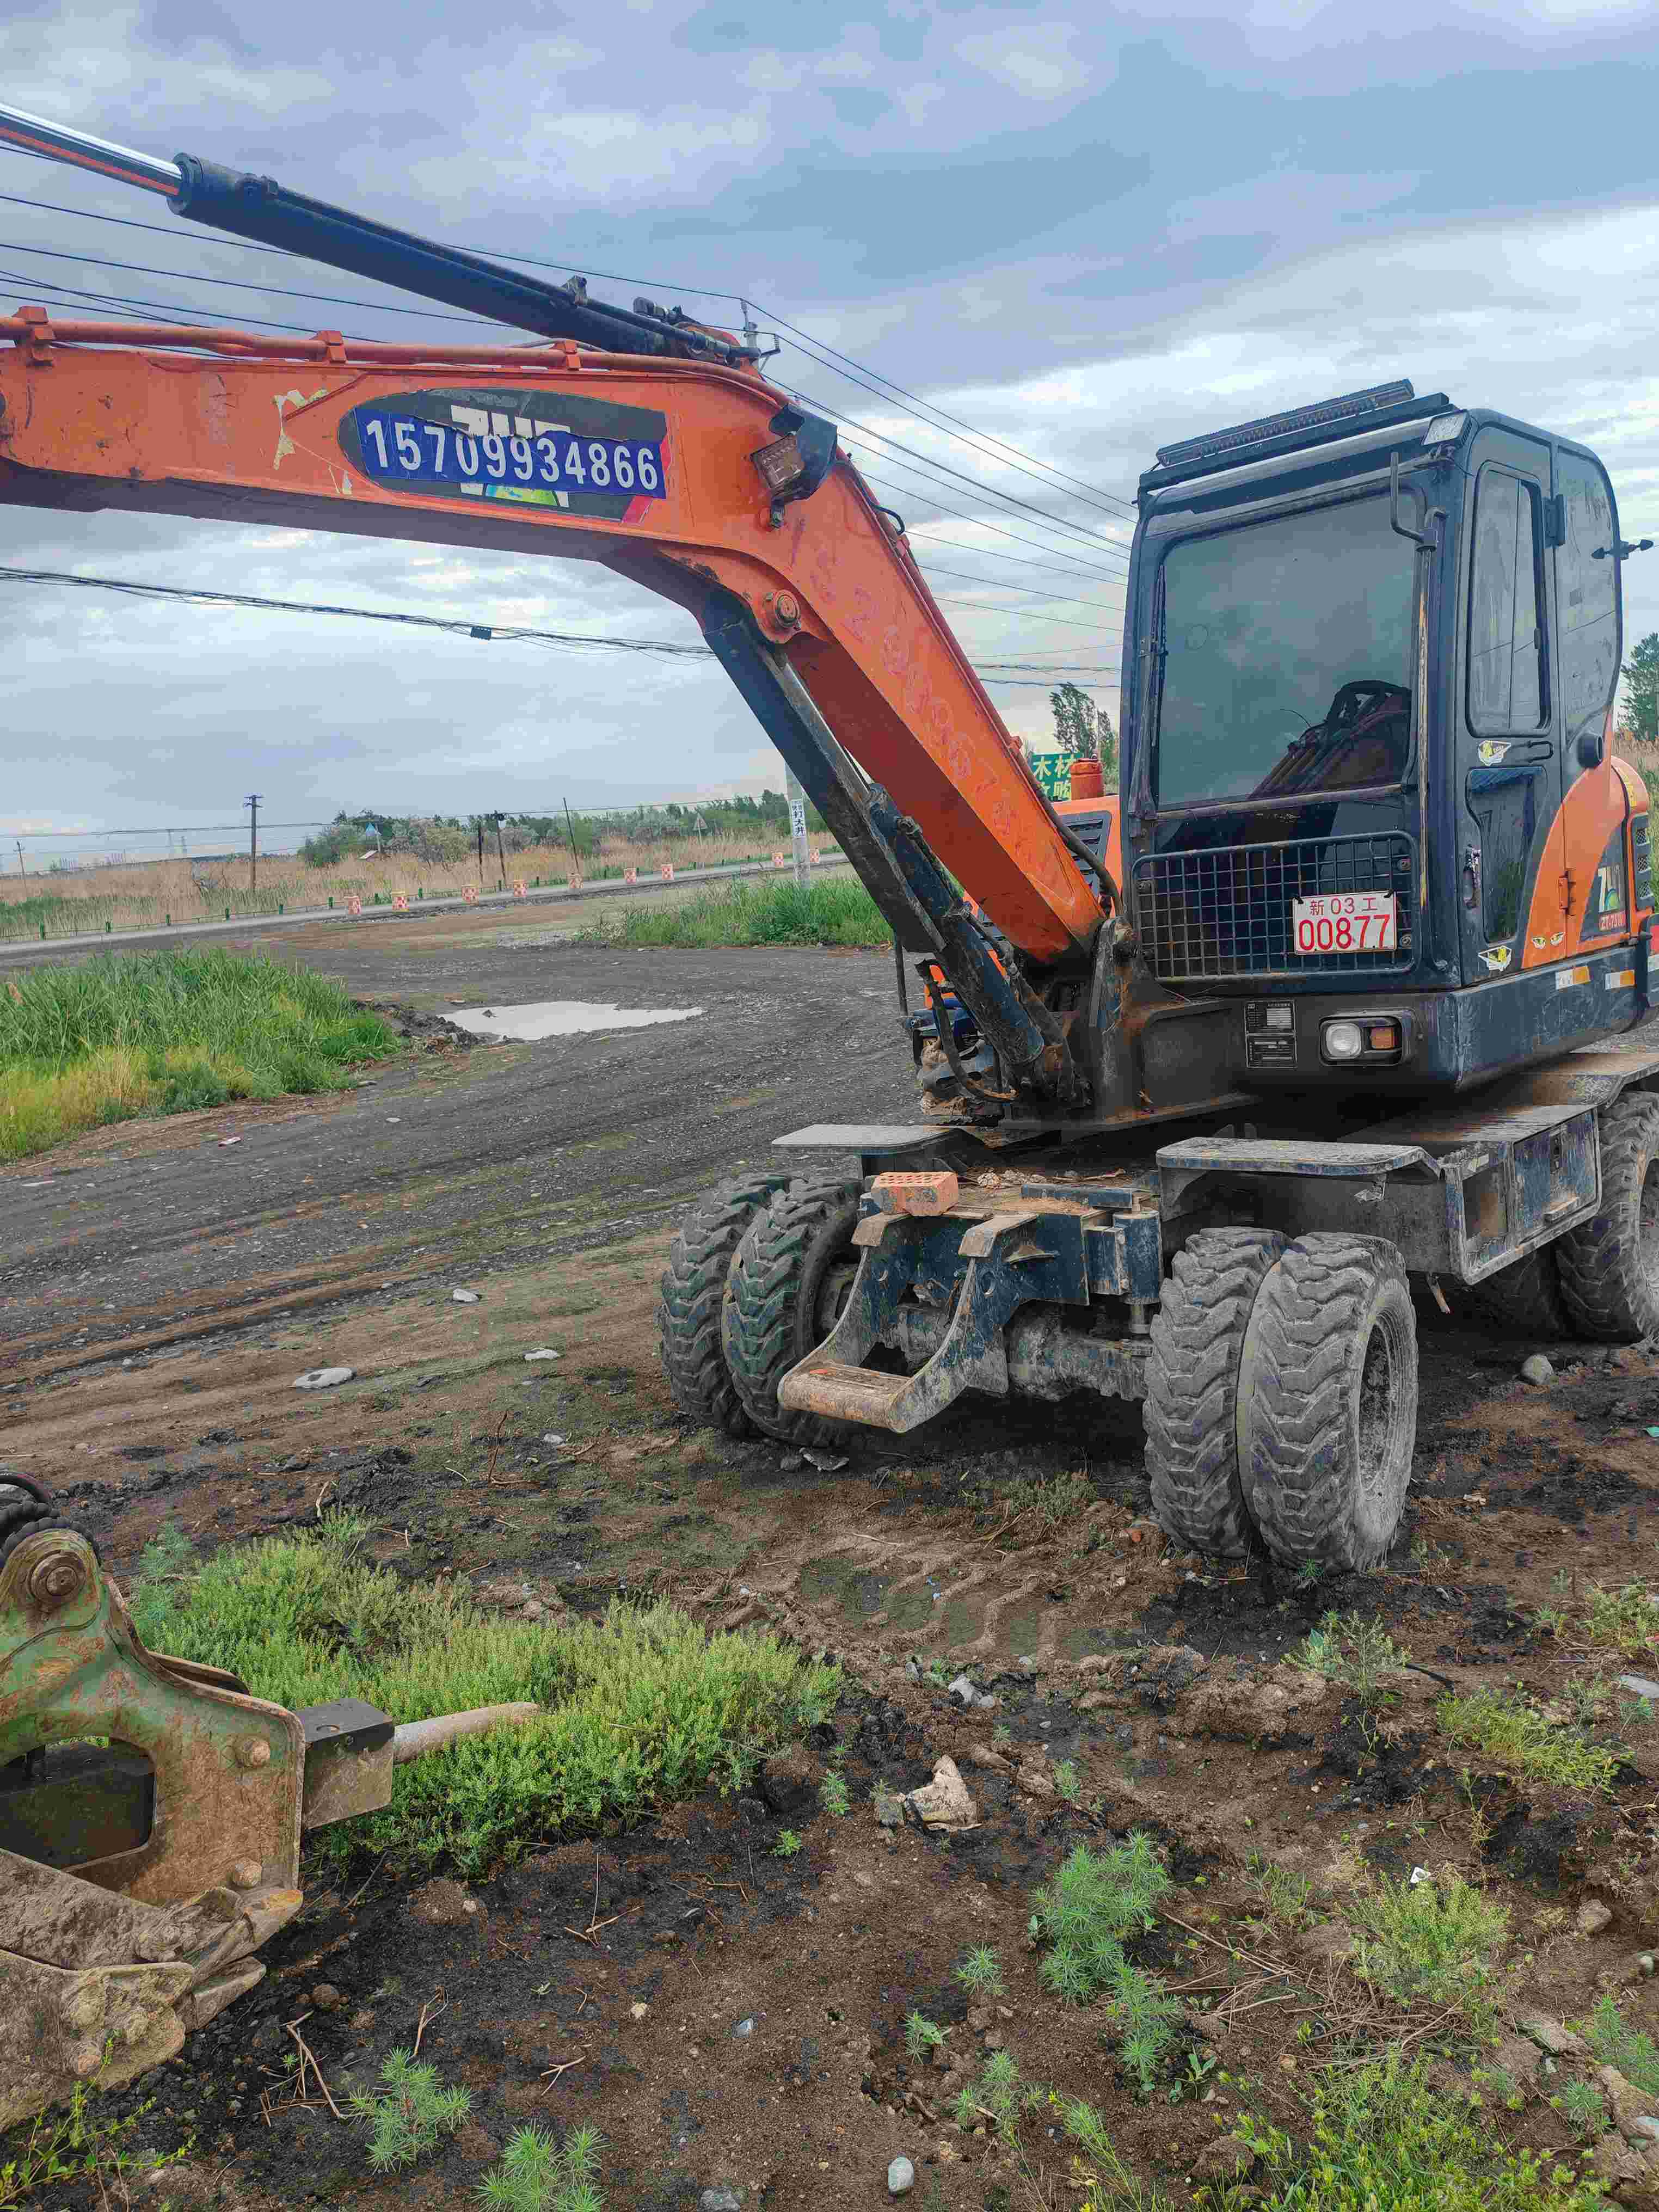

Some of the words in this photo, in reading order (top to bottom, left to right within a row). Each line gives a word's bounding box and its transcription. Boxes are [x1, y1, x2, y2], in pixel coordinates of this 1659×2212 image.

[366, 420, 658, 490] 15709934866
[1033, 754, 1076, 779] 木材
[1299, 914, 1390, 950] 00877
